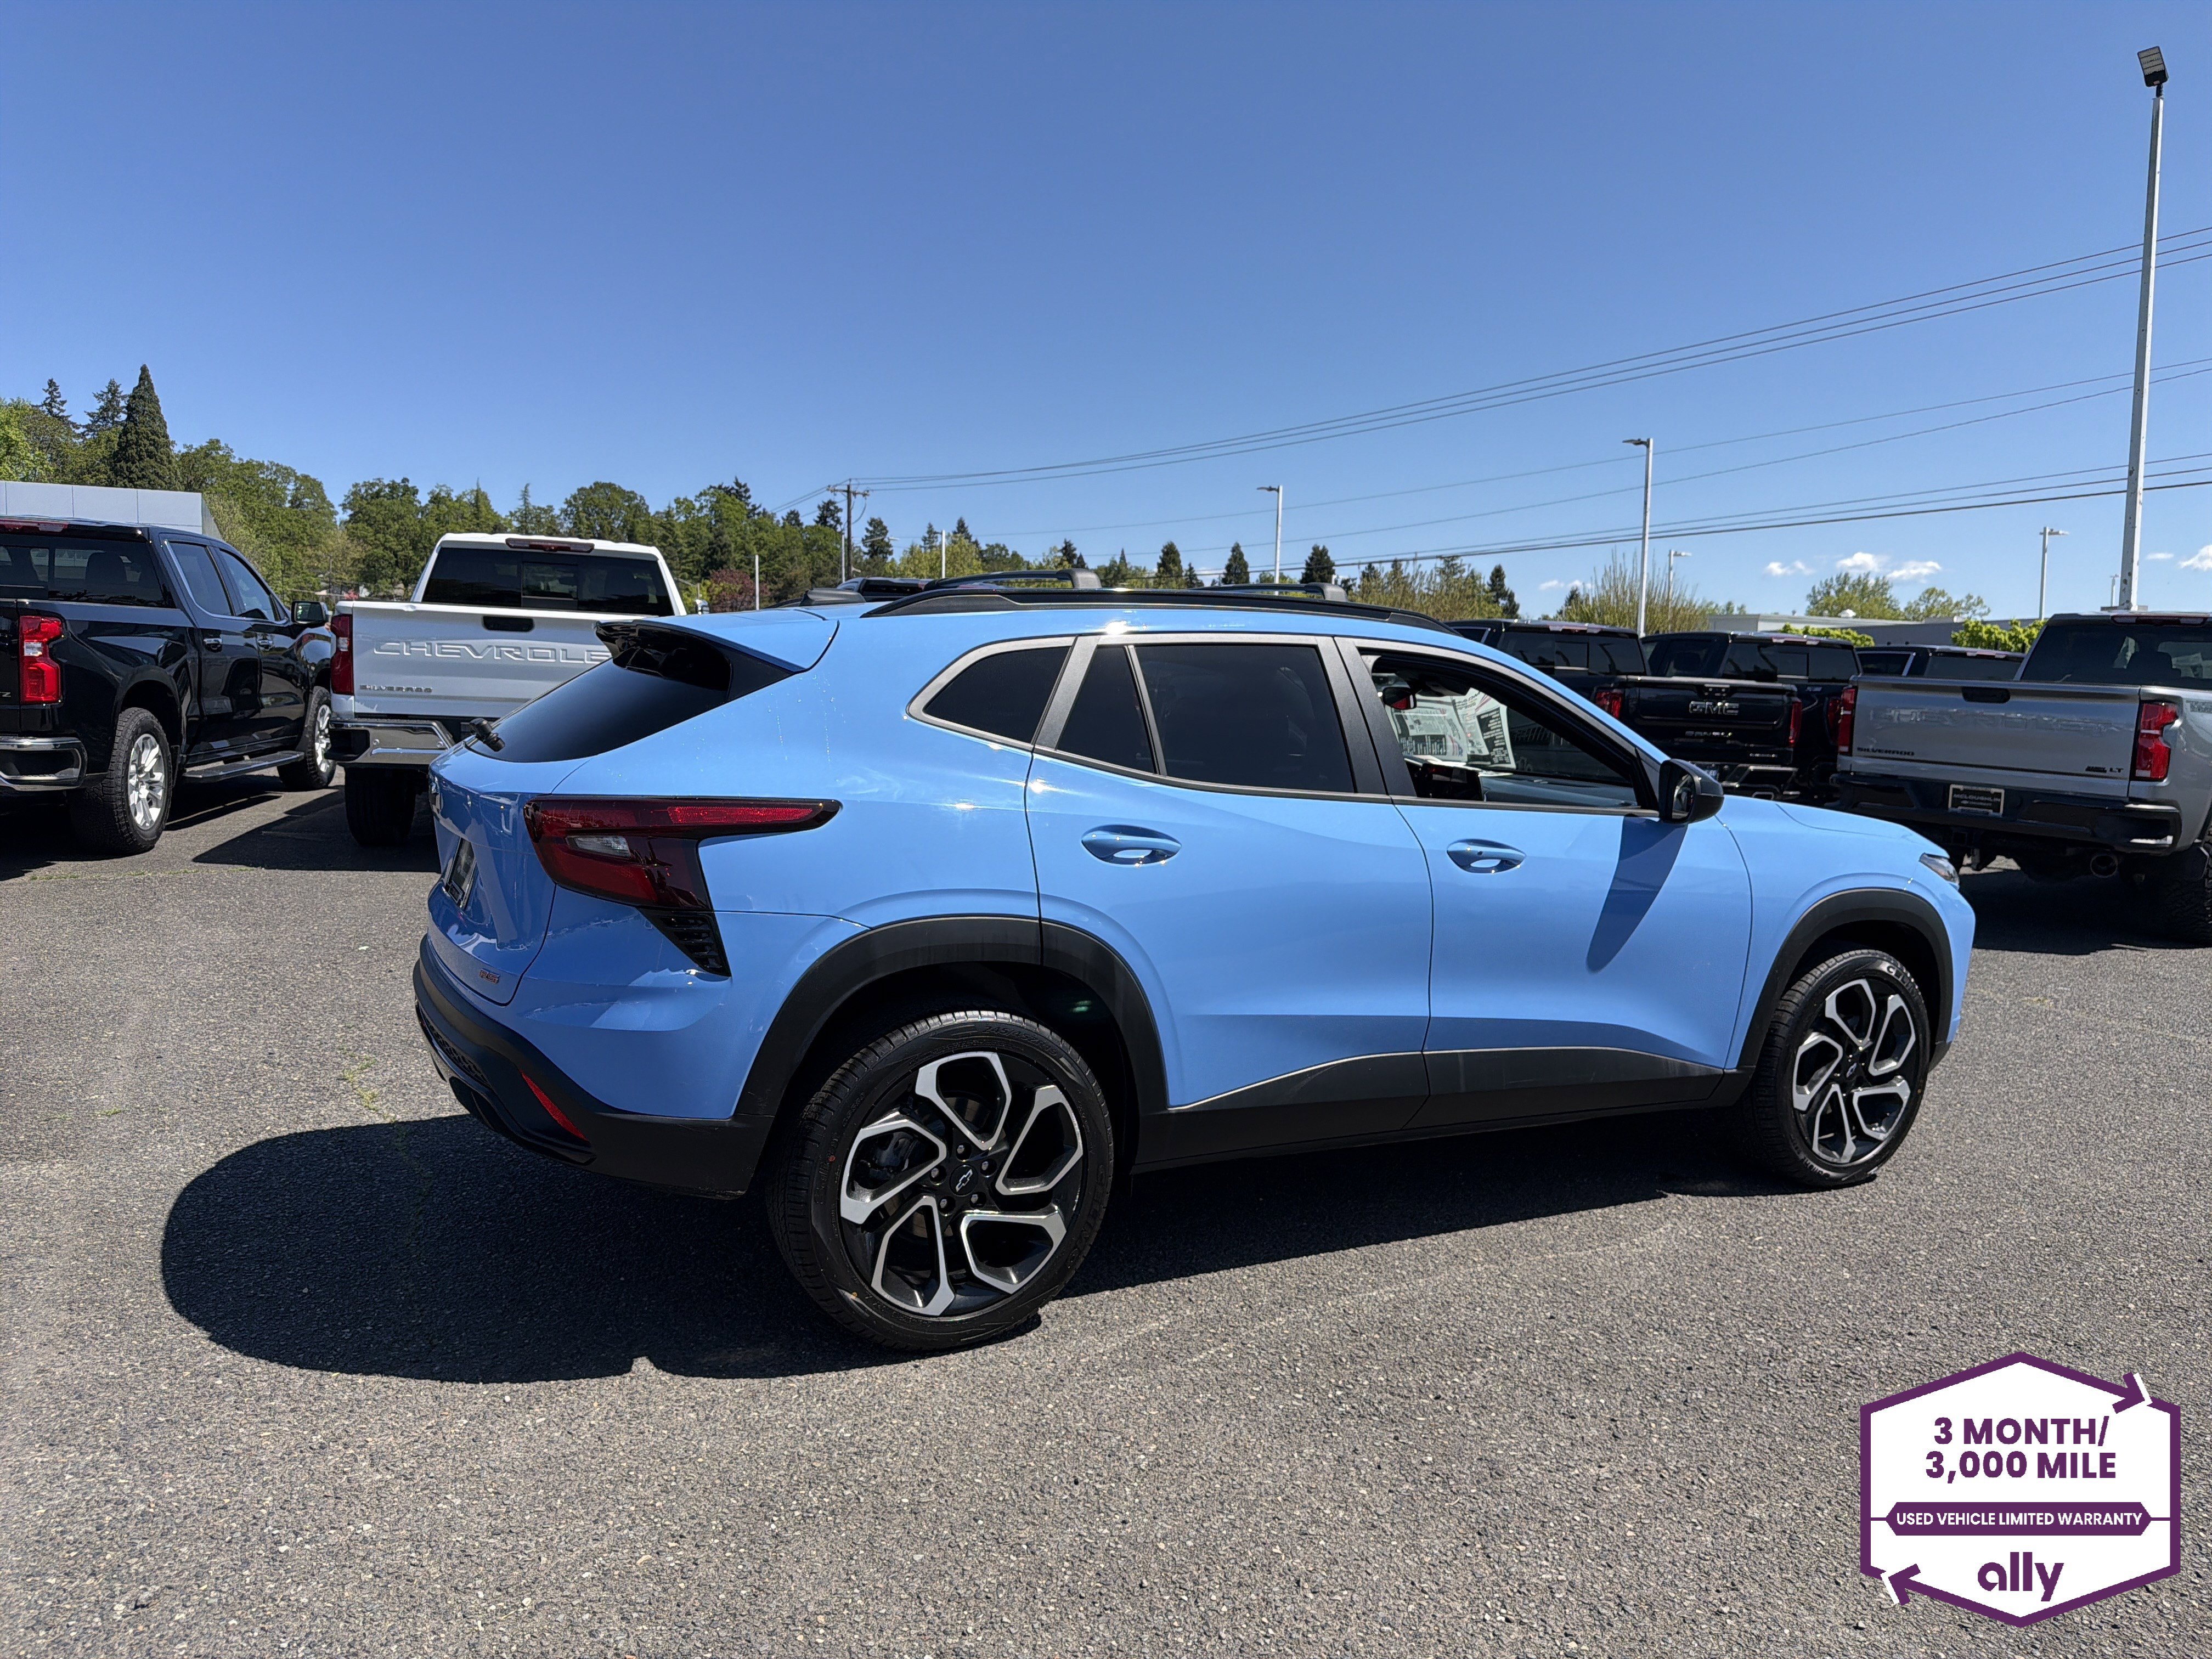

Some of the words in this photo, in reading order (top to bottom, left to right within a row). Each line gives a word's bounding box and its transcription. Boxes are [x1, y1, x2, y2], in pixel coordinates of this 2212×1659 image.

[373, 640, 612, 664] CHEVROLE
[1689, 700, 1740, 716] GMC
[479, 968, 501, 984] RS
